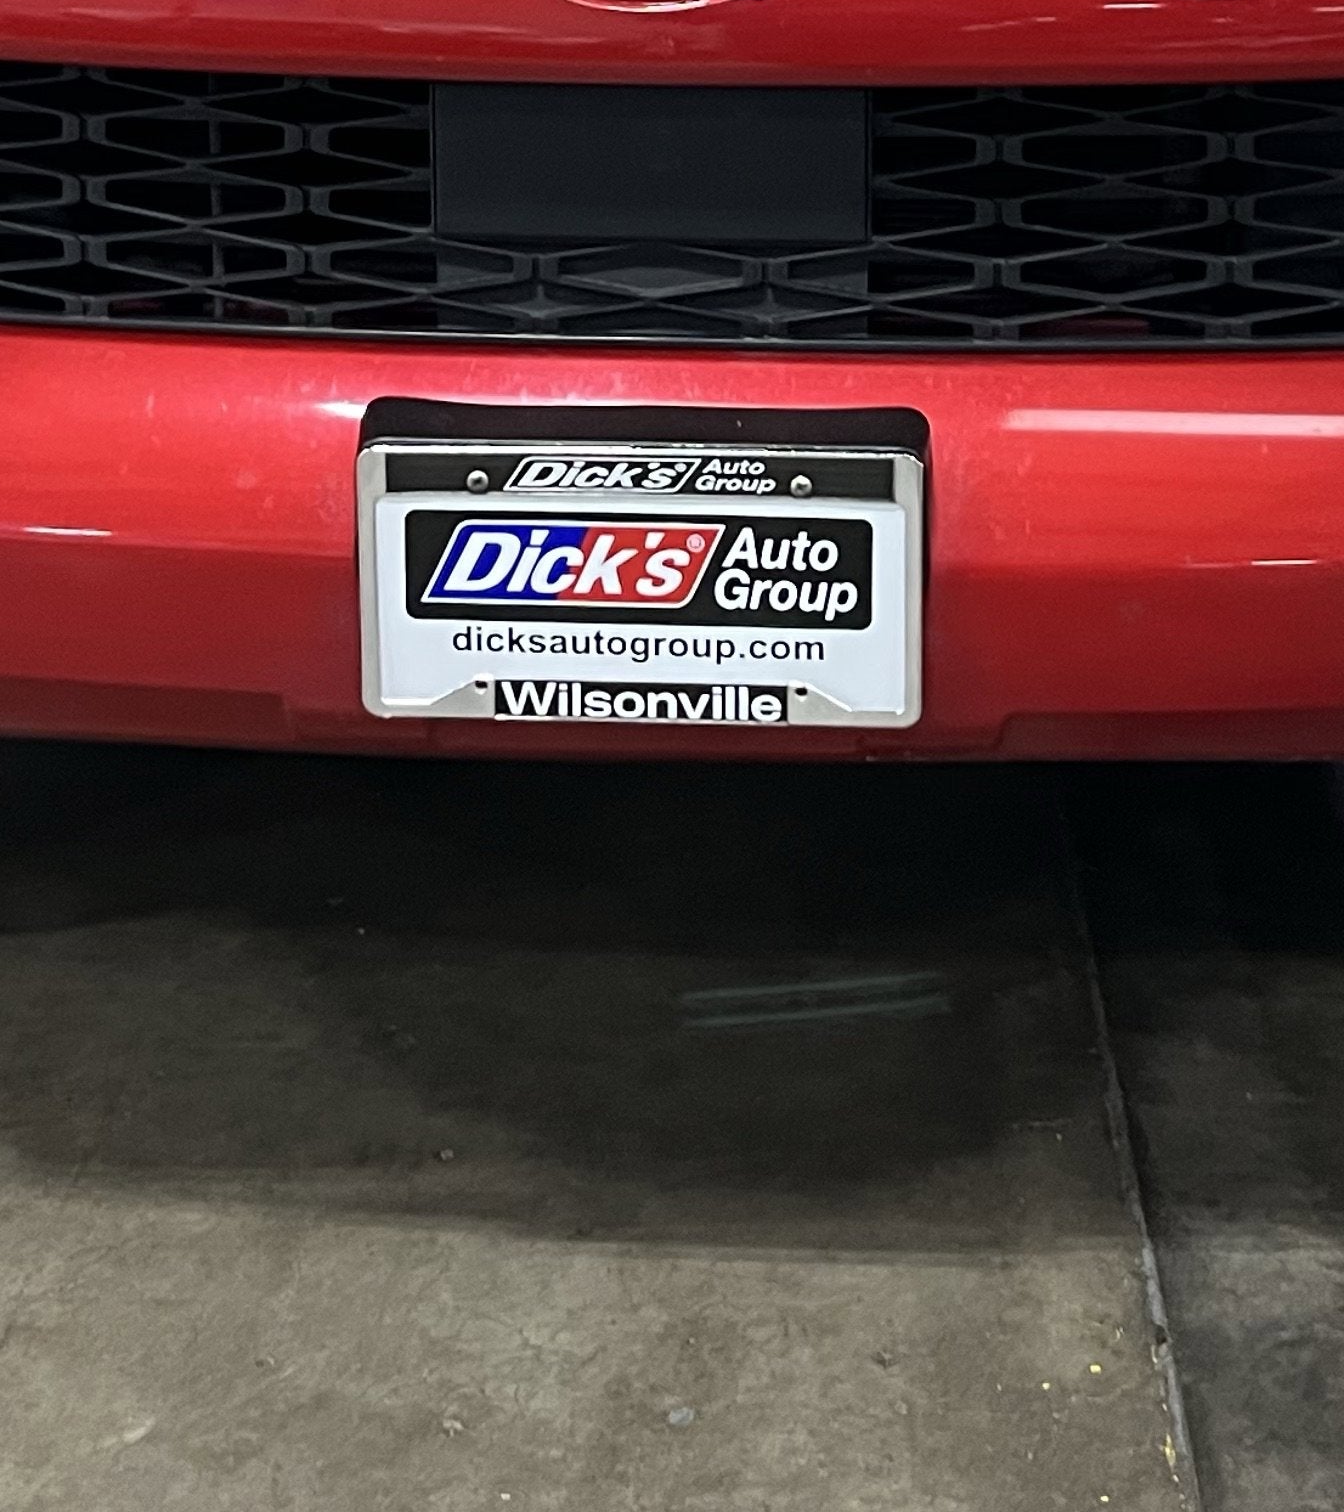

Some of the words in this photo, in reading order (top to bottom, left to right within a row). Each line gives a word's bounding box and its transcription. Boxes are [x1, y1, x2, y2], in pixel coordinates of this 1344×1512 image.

[517, 461, 677, 488] Dick's
[695, 475, 776, 494] Group
[703, 459, 765, 475] Auto
[443, 529, 691, 597] Dick's
[722, 527, 839, 571] Auto
[714, 569, 858, 621] Group
[452, 626, 826, 664] dicksautogroup.com
[499, 681, 783, 723] Wilsonville
